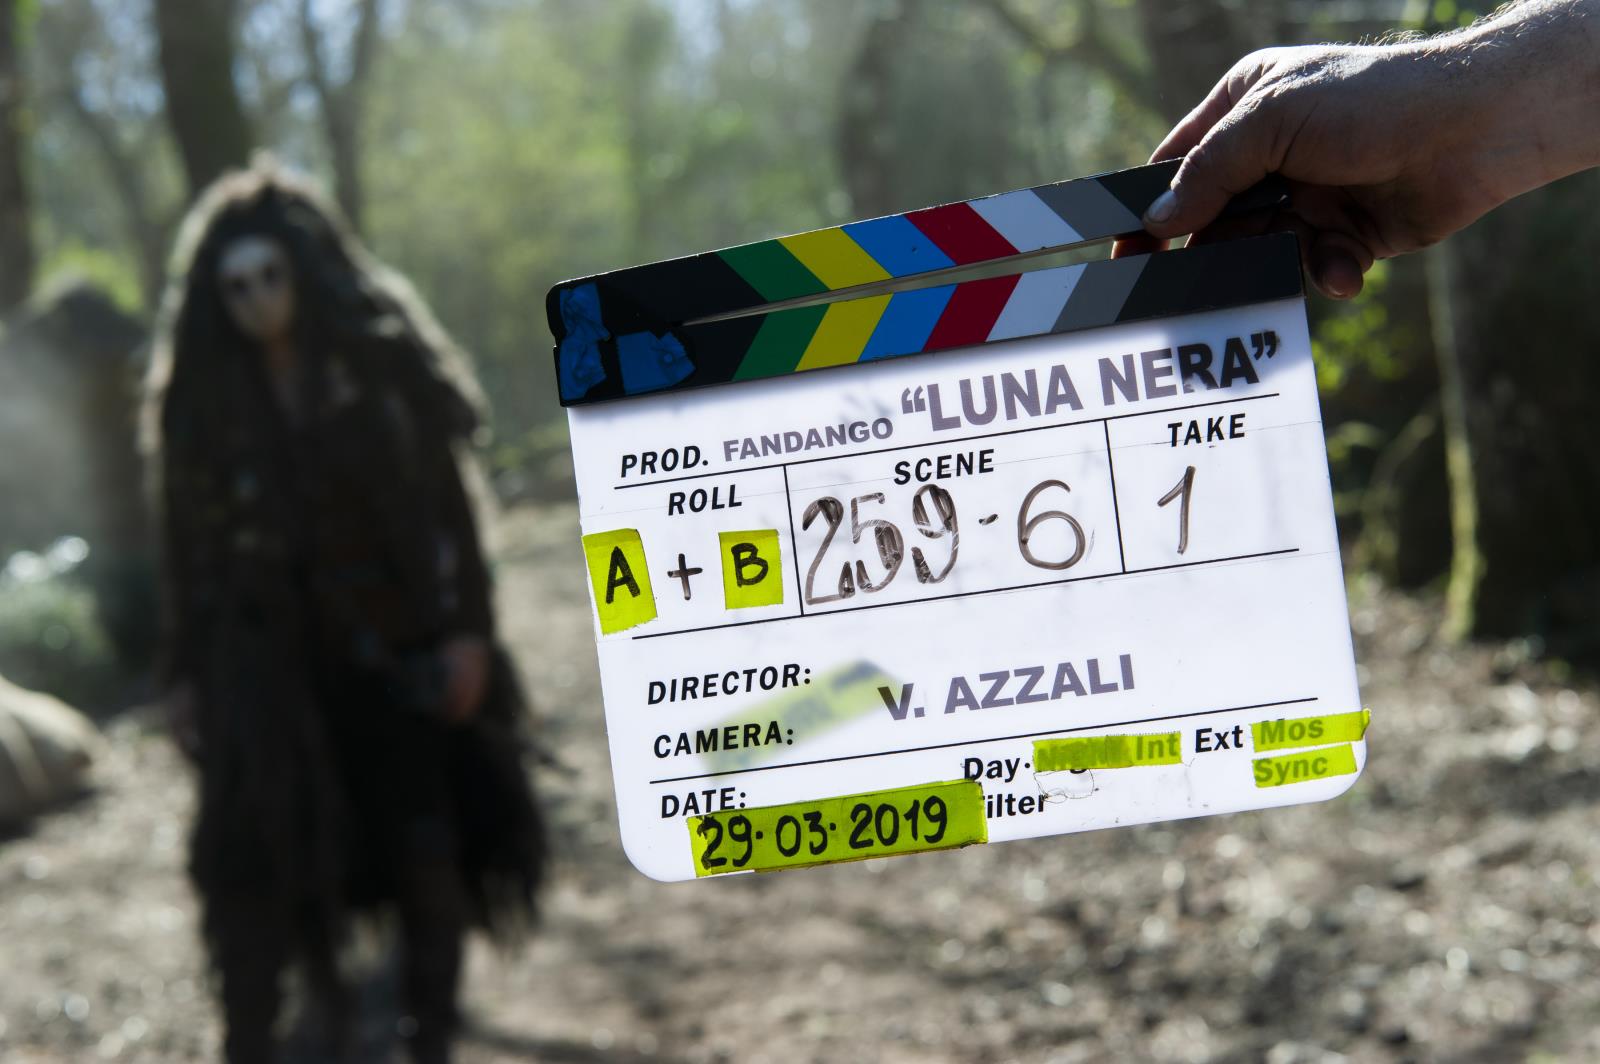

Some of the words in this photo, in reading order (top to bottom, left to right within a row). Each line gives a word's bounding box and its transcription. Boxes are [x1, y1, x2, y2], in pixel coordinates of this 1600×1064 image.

[620, 445, 709, 477] PROD.
[722, 417, 893, 462] FANDANGO
[1167, 413, 1246, 447] TAKE
[893, 449, 995, 485] SCENE
[668, 484, 743, 516] ROLL
[1157, 465, 1196, 554] 1
[605, 546, 641, 604] A
[731, 542, 769, 588] B
[647, 663, 812, 705] DIRECTOR:
[877, 683, 926, 721] V.
[943, 653, 1135, 714] AZZALI
[653, 721, 794, 759] CAMERA:
[1136, 734, 1178, 760] Int
[1195, 725, 1244, 753] Ext
[1259, 717, 1324, 745] Mos
[1254, 753, 1328, 786] Sync
[661, 787, 747, 818] DATE:
[983, 793, 1045, 818] ilter
